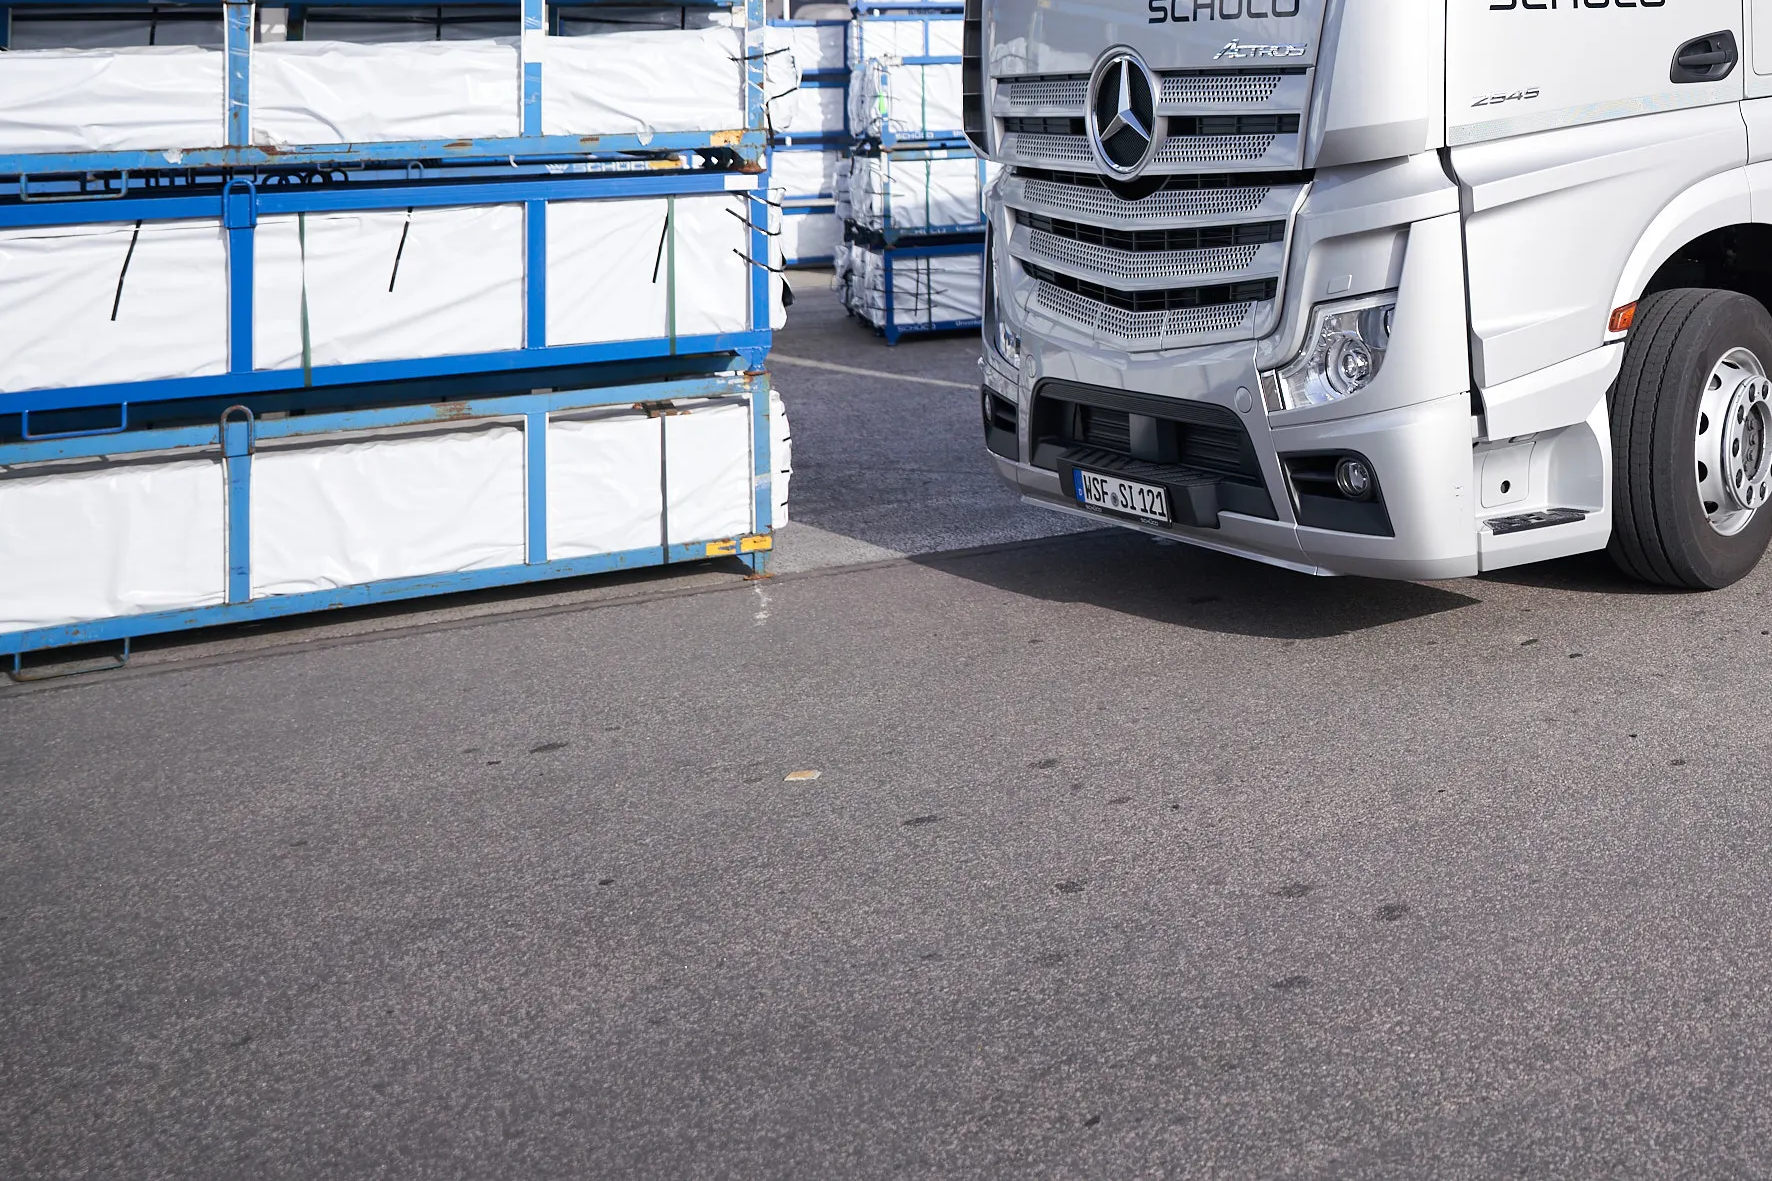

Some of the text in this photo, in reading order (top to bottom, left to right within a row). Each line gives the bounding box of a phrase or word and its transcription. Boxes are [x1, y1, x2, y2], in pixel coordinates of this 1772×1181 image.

[1083, 475, 1167, 517] WSF SI 121
